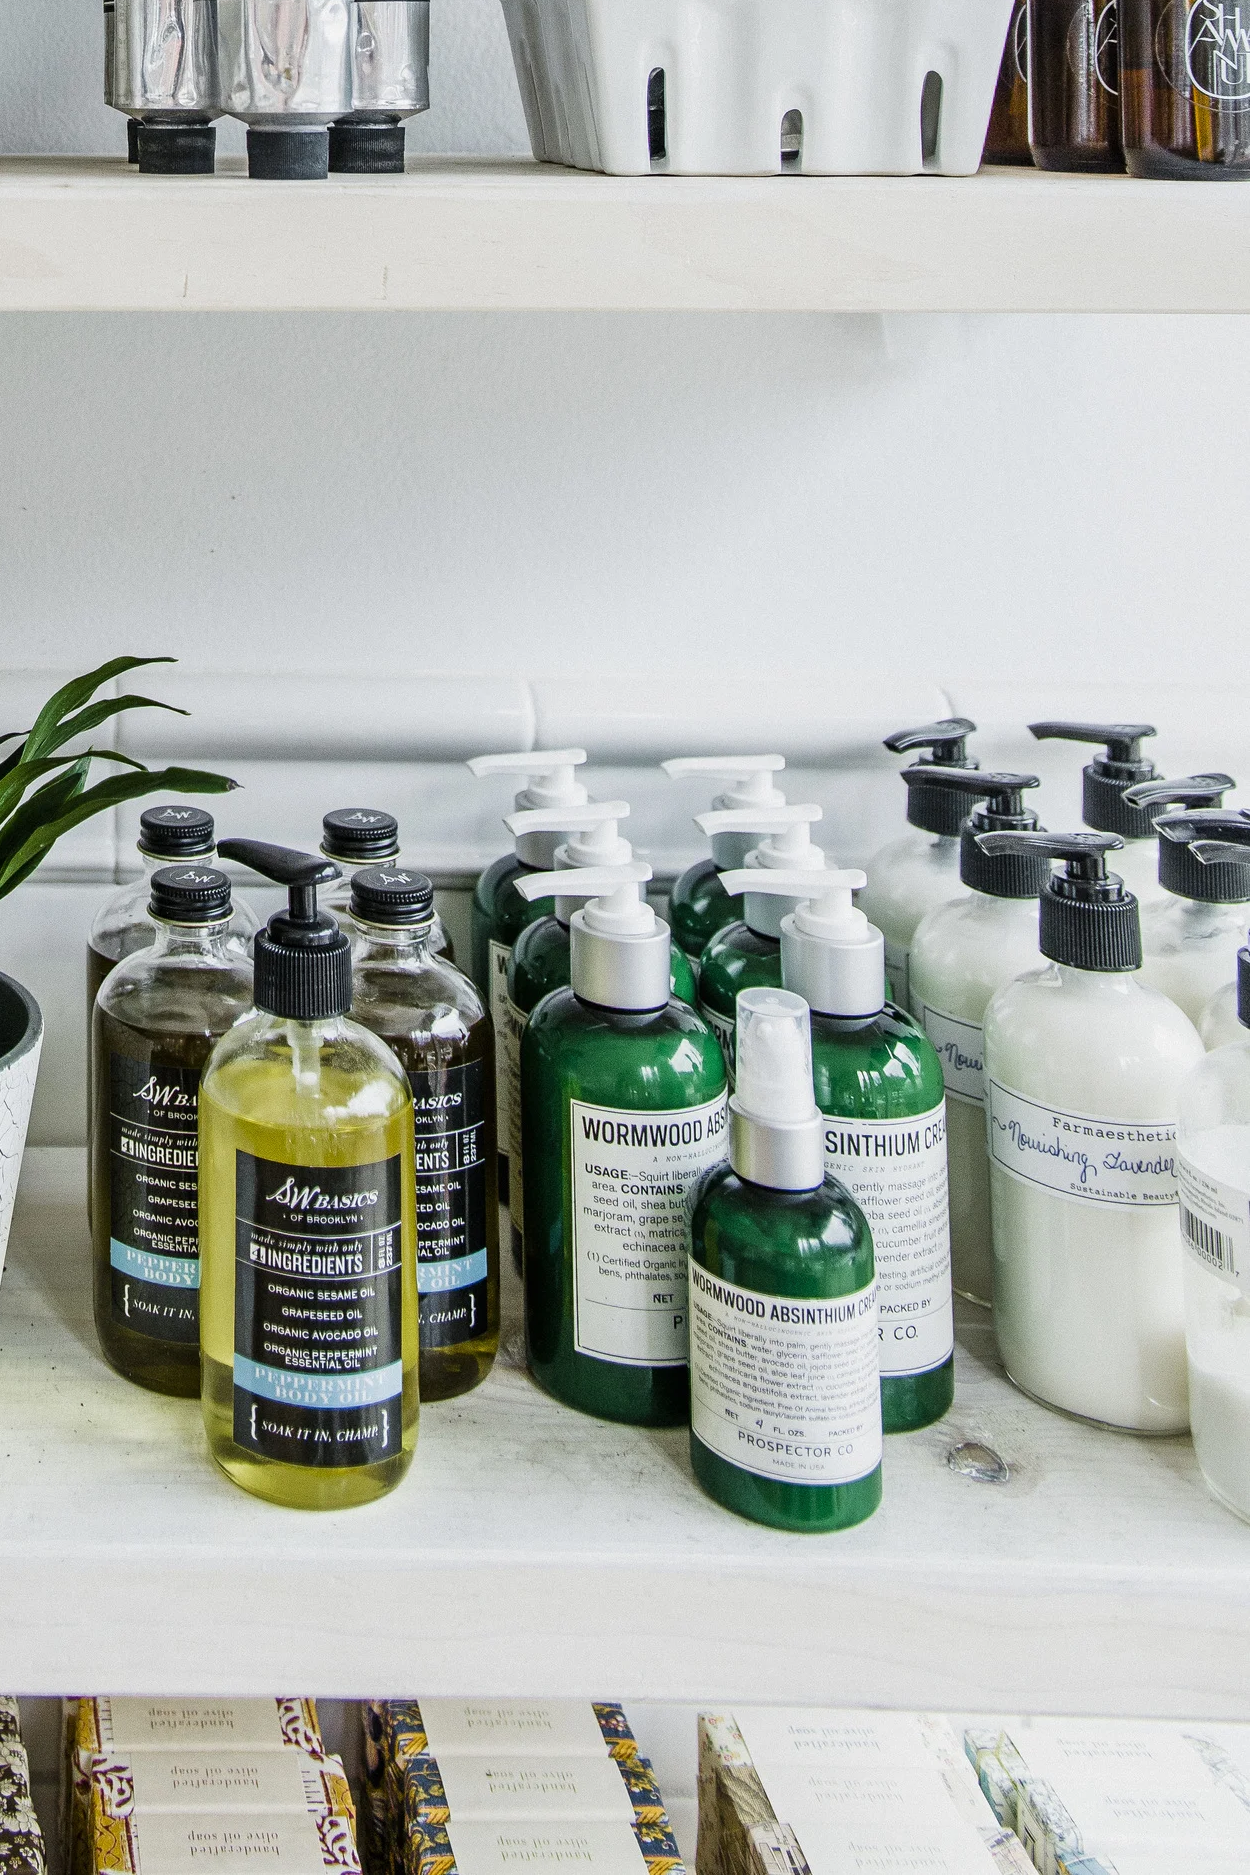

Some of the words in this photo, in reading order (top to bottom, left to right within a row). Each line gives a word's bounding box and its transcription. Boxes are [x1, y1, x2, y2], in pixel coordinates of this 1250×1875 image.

[582, 1115, 703, 1147] WORMWOOD
[314, 1189, 379, 1209] BASICS
[1070, 1182, 1137, 1200] Sustainable
[290, 1214, 304, 1222] OF
[307, 1215, 358, 1224] BROOKLYN
[594, 1223, 631, 1237] extract
[251, 1232, 275, 1247] made
[278, 1240, 312, 1256] simply
[315, 1242, 340, 1254] with
[342, 1241, 363, 1254] only
[623, 1242, 677, 1252] echinacea
[250, 1242, 266, 1265] 4
[268, 1250, 363, 1274] INGREDIENTS
[268, 1284, 314, 1300] ORGANIC
[317, 1291, 358, 1300] SESAME
[360, 1288, 375, 1299] OIL
[691, 1266, 766, 1318] WORMWOOD
[770, 1304, 856, 1325] ABSINTHIUM
[282, 1307, 343, 1320] GRAPESEED
[346, 1308, 362, 1319] OIL
[880, 1304, 919, 1314] PACKED
[921, 1299, 932, 1309] BY
[263, 1322, 309, 1339] ORGANIC
[312, 1329, 361, 1341] AVOCADO
[363, 1327, 378, 1338] OIL
[264, 1342, 310, 1360] ORGANIC
[312, 1346, 378, 1362] PEPPERMINT
[285, 1357, 341, 1369] ESSENTIAL
[345, 1358, 360, 1368] OIL
[254, 1366, 385, 1391] PEPPERMINT
[274, 1386, 336, 1405] BODY
[339, 1388, 372, 1404] OIL
[724, 1408, 740, 1421] NET
[261, 1419, 292, 1438] SOAK
[297, 1427, 311, 1440] IT
[314, 1429, 332, 1442] IN,
[738, 1430, 832, 1458] PROSPECTOR
[187, 1830, 218, 1840] soap
[224, 1832, 241, 1843] oil
[246, 1832, 279, 1844] olive
[190, 1846, 280, 1856] handcrafted
